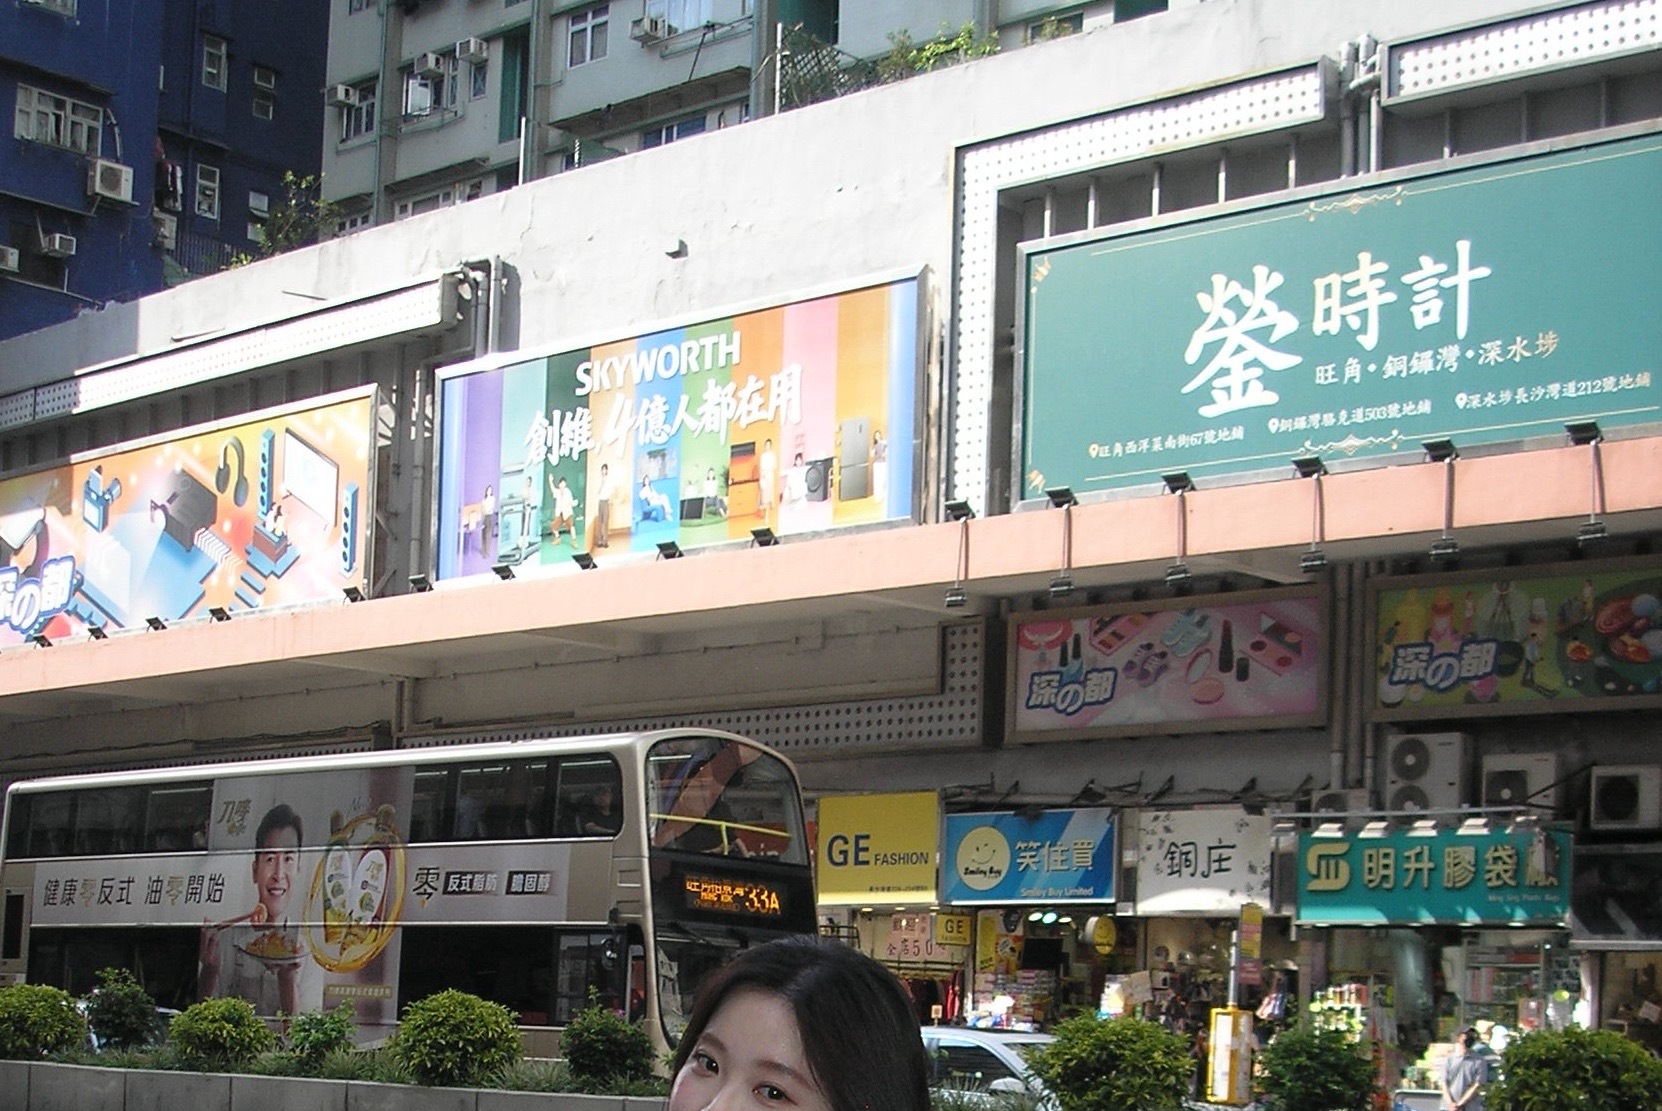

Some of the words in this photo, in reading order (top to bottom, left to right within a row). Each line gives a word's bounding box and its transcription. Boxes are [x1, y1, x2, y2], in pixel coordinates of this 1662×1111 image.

[575, 331, 741, 396] SKYWORTH
[1391, 641, 1496, 690] 深の都
[1028, 670, 1115, 715] 深の都
[827, 833, 871, 868] GE
[875, 852, 929, 866] FASHION
[43, 876, 136, 908] 健康零反式
[144, 873, 225, 907] 油零開始
[412, 866, 440, 908] 零
[745, 884, 782, 915] 33A
[1065, 886, 1094, 897] Limited
[945, 919, 963, 935] GE
